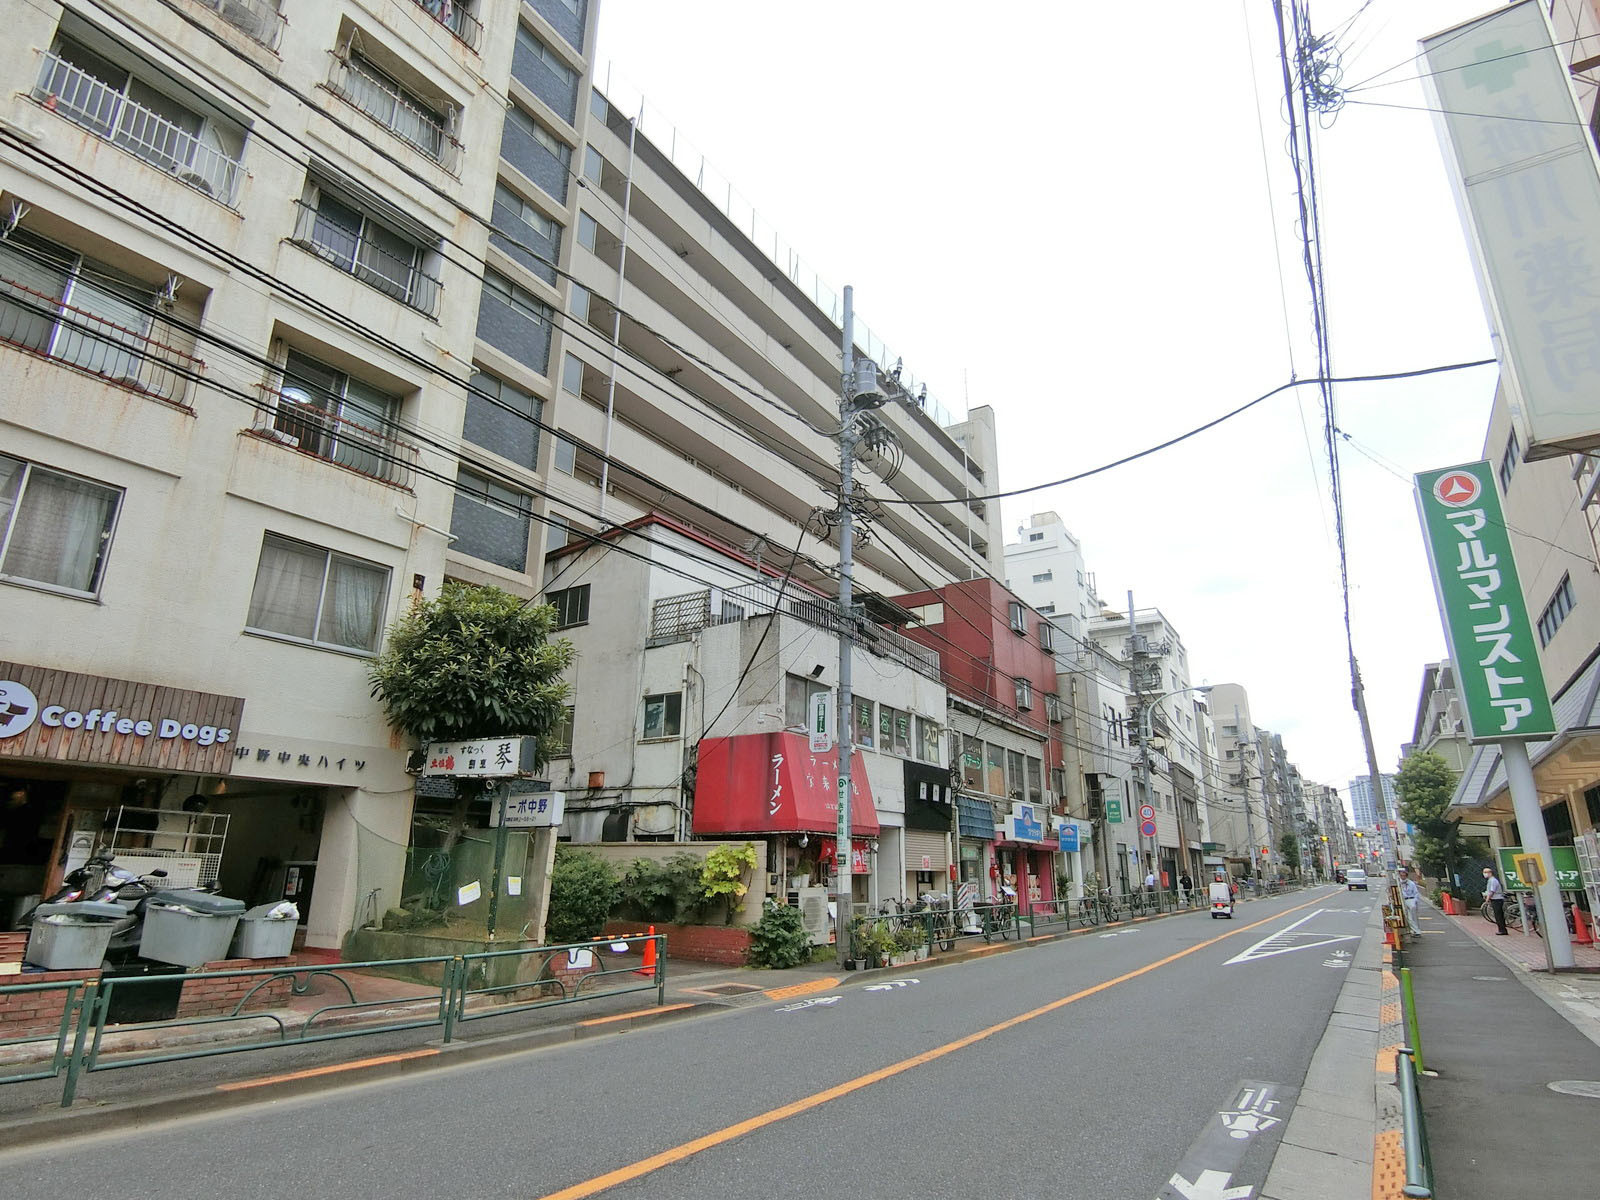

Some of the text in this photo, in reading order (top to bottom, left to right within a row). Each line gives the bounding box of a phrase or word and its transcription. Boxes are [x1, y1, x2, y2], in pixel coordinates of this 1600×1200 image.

[1446, 508, 1532, 733] マルマンストア
[41, 705, 232, 746] Coffee Dogs
[235, 746, 366, 771] 中野中央ハイツ
[460, 744, 485, 755] すなっく
[494, 742, 513, 770] 琴
[809, 755, 838, 771] ラーメ
[769, 753, 784, 816] ラーメン
[1143, 808, 1152, 817] 40
